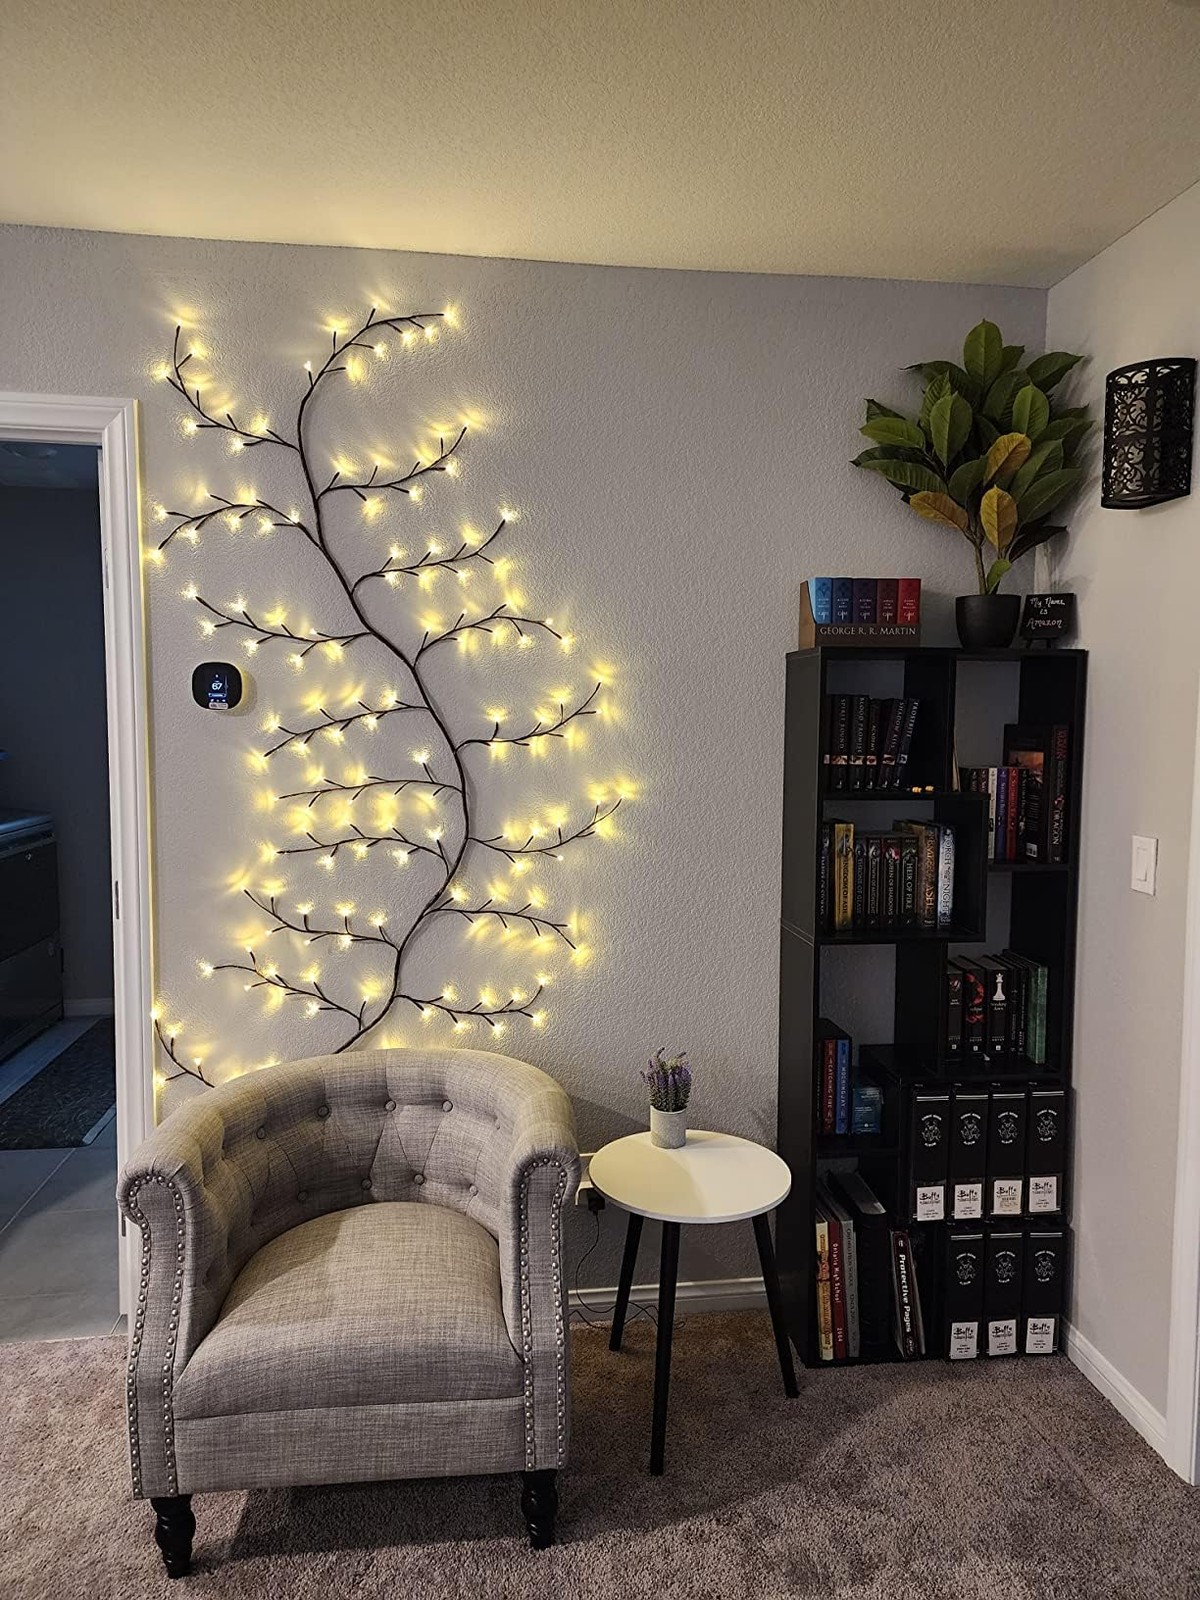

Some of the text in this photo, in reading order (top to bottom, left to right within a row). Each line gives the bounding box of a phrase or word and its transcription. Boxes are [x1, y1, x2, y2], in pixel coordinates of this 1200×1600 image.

[1030, 597, 1042, 608] My
[1025, 617, 1063, 630] Amazon
[820, 626, 916, 636] GEORGE R. R. MARTIN
[211, 682, 223, 691] 67
[894, 701, 904, 731] SHADOW
[1052, 809, 1060, 845] DRAGON
[906, 882, 913, 892] OF
[898, 1254, 912, 1333] Protective Pages
